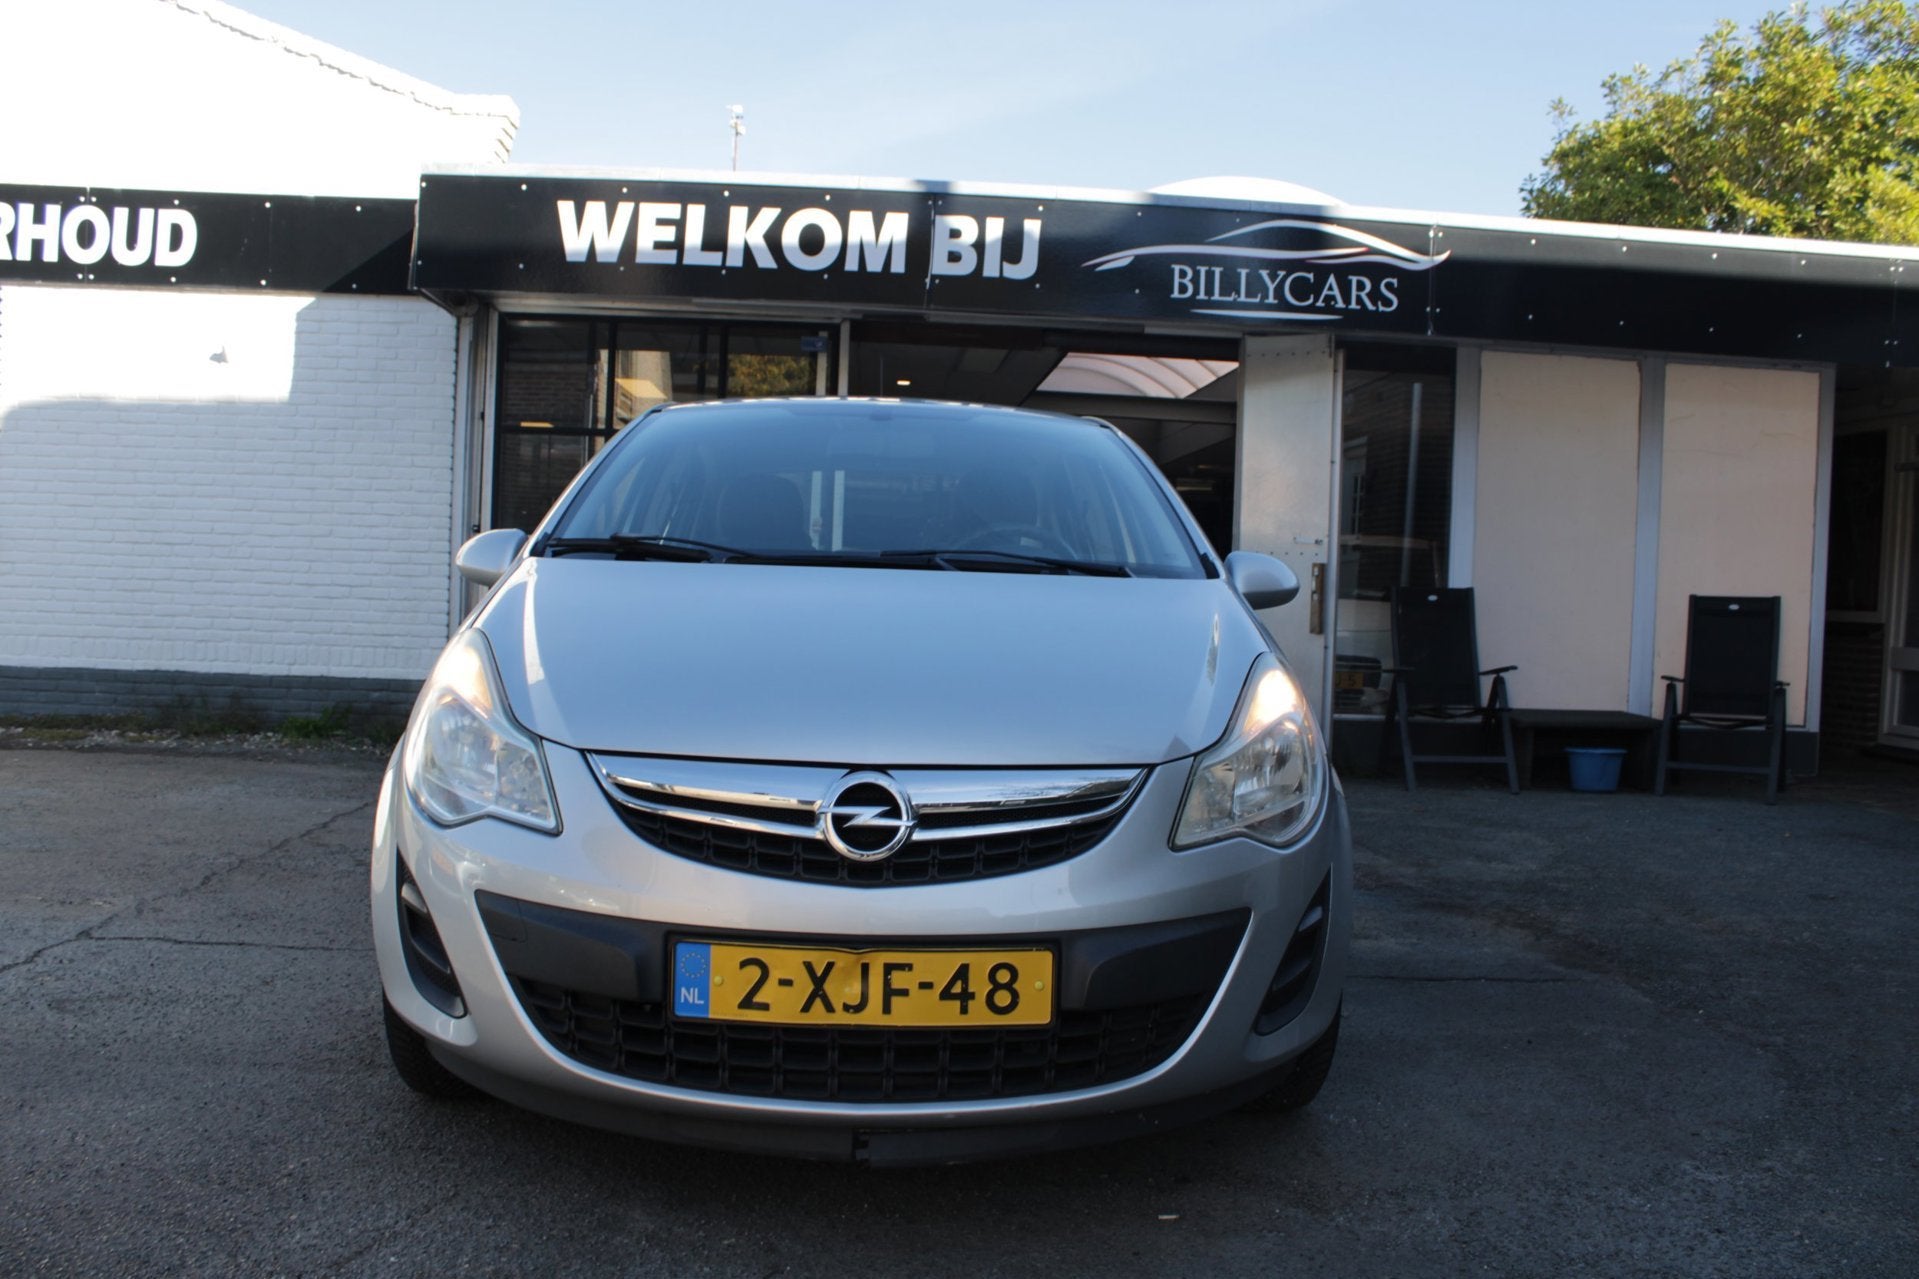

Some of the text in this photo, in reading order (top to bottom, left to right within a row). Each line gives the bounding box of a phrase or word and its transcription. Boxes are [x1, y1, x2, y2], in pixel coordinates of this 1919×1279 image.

[556, 199, 1043, 280] WELKOM BIJ
[1170, 264, 1399, 312] BILLYCARS
[680, 987, 704, 1005] NL
[737, 957, 1021, 1016] 2-XJF-48
